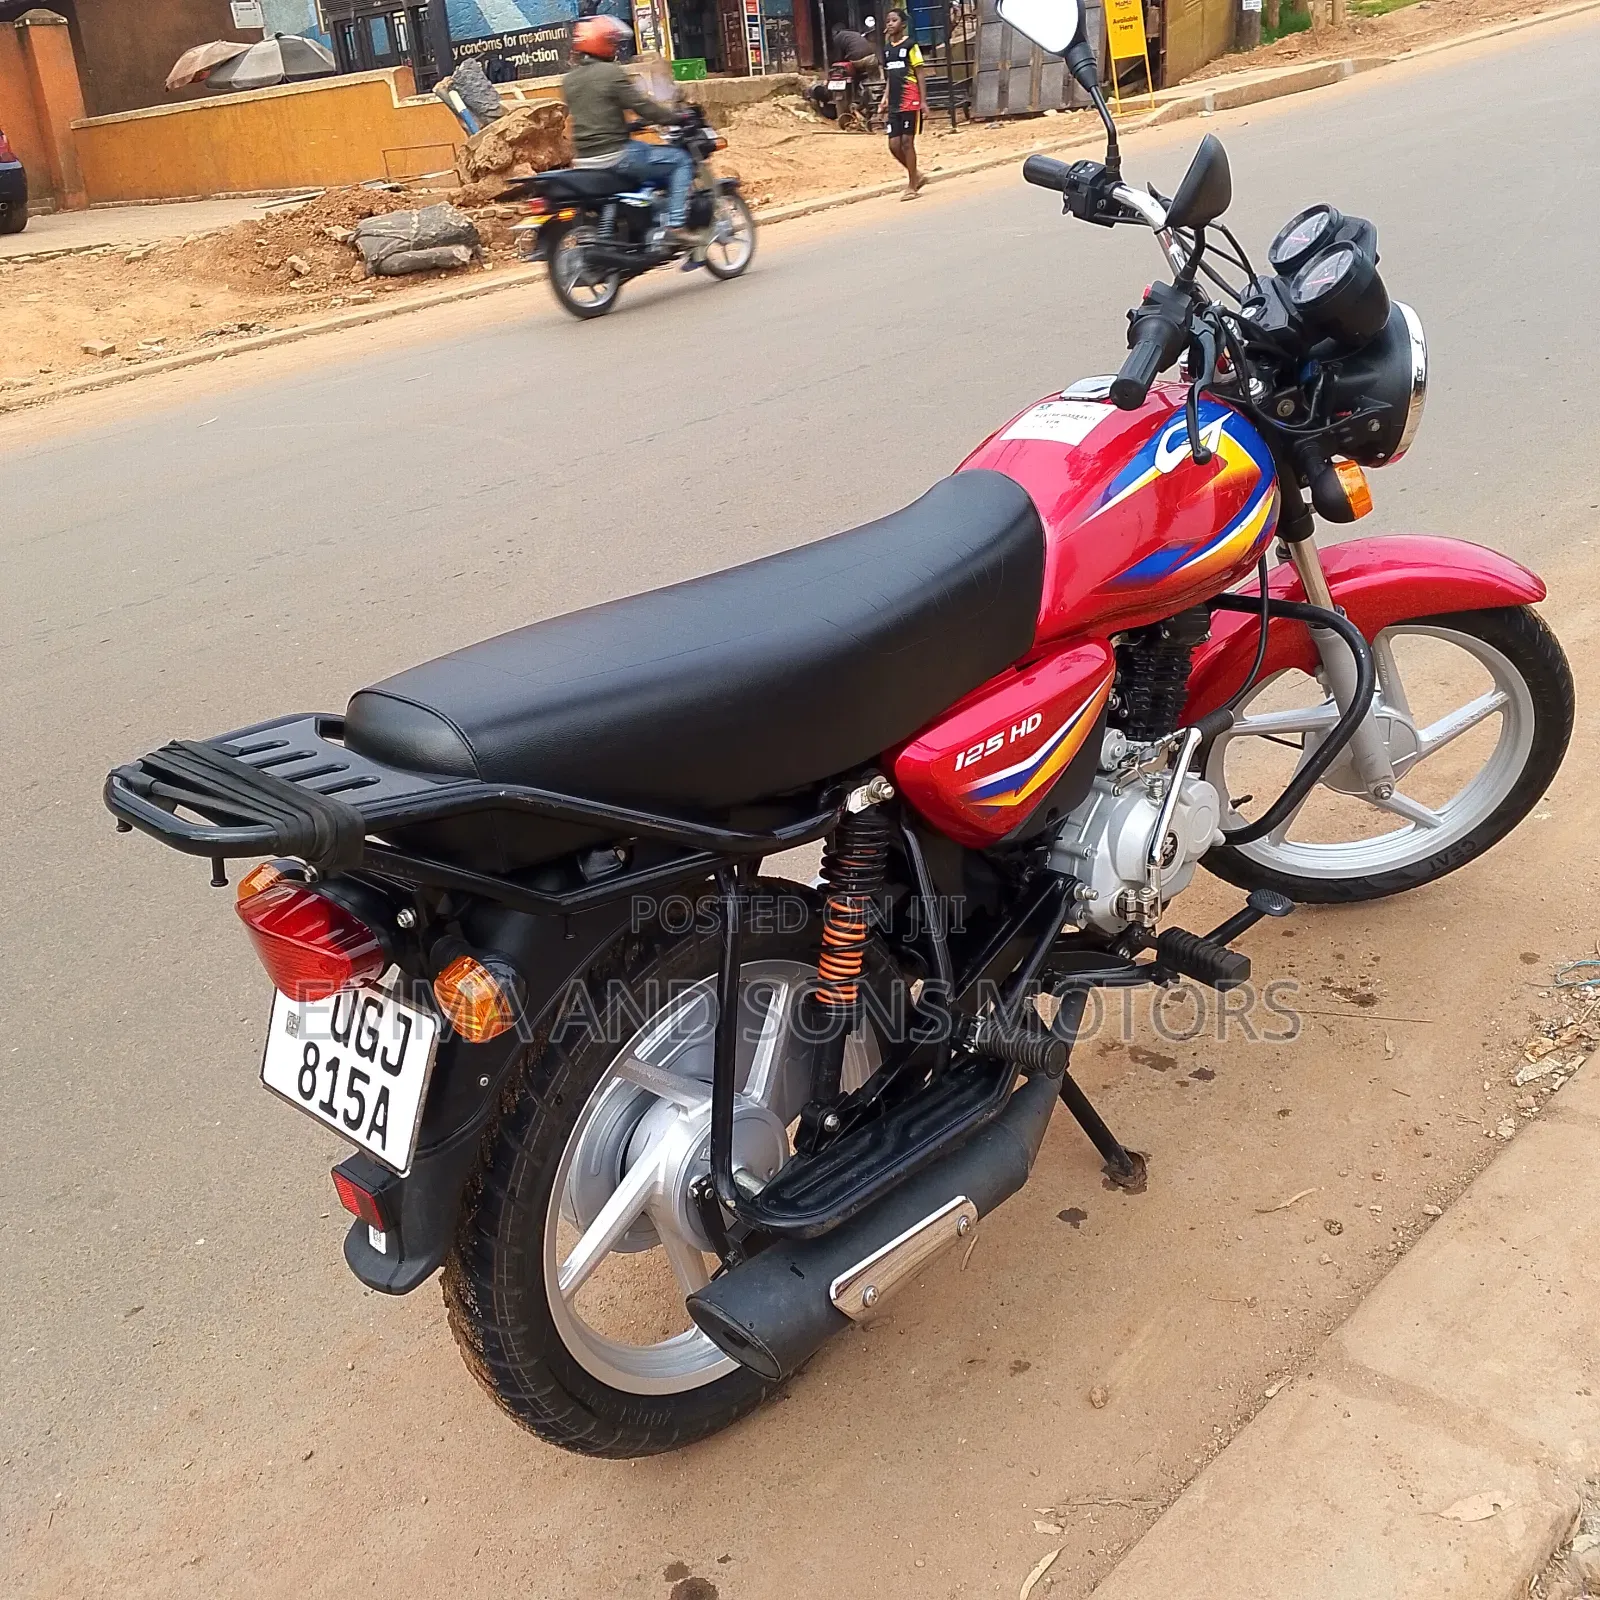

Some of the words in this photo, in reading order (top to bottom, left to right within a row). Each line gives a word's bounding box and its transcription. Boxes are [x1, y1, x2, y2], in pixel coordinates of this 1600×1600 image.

[503, 34, 517, 48] for
[1113, 15, 1139, 25] Available
[954, 731, 1005, 771] 125
[1009, 712, 1043, 743] HD
[1429, 839, 1477, 873] CEAT
[331, 990, 412, 1077] UGJ
[298, 1041, 389, 1151] 815A
